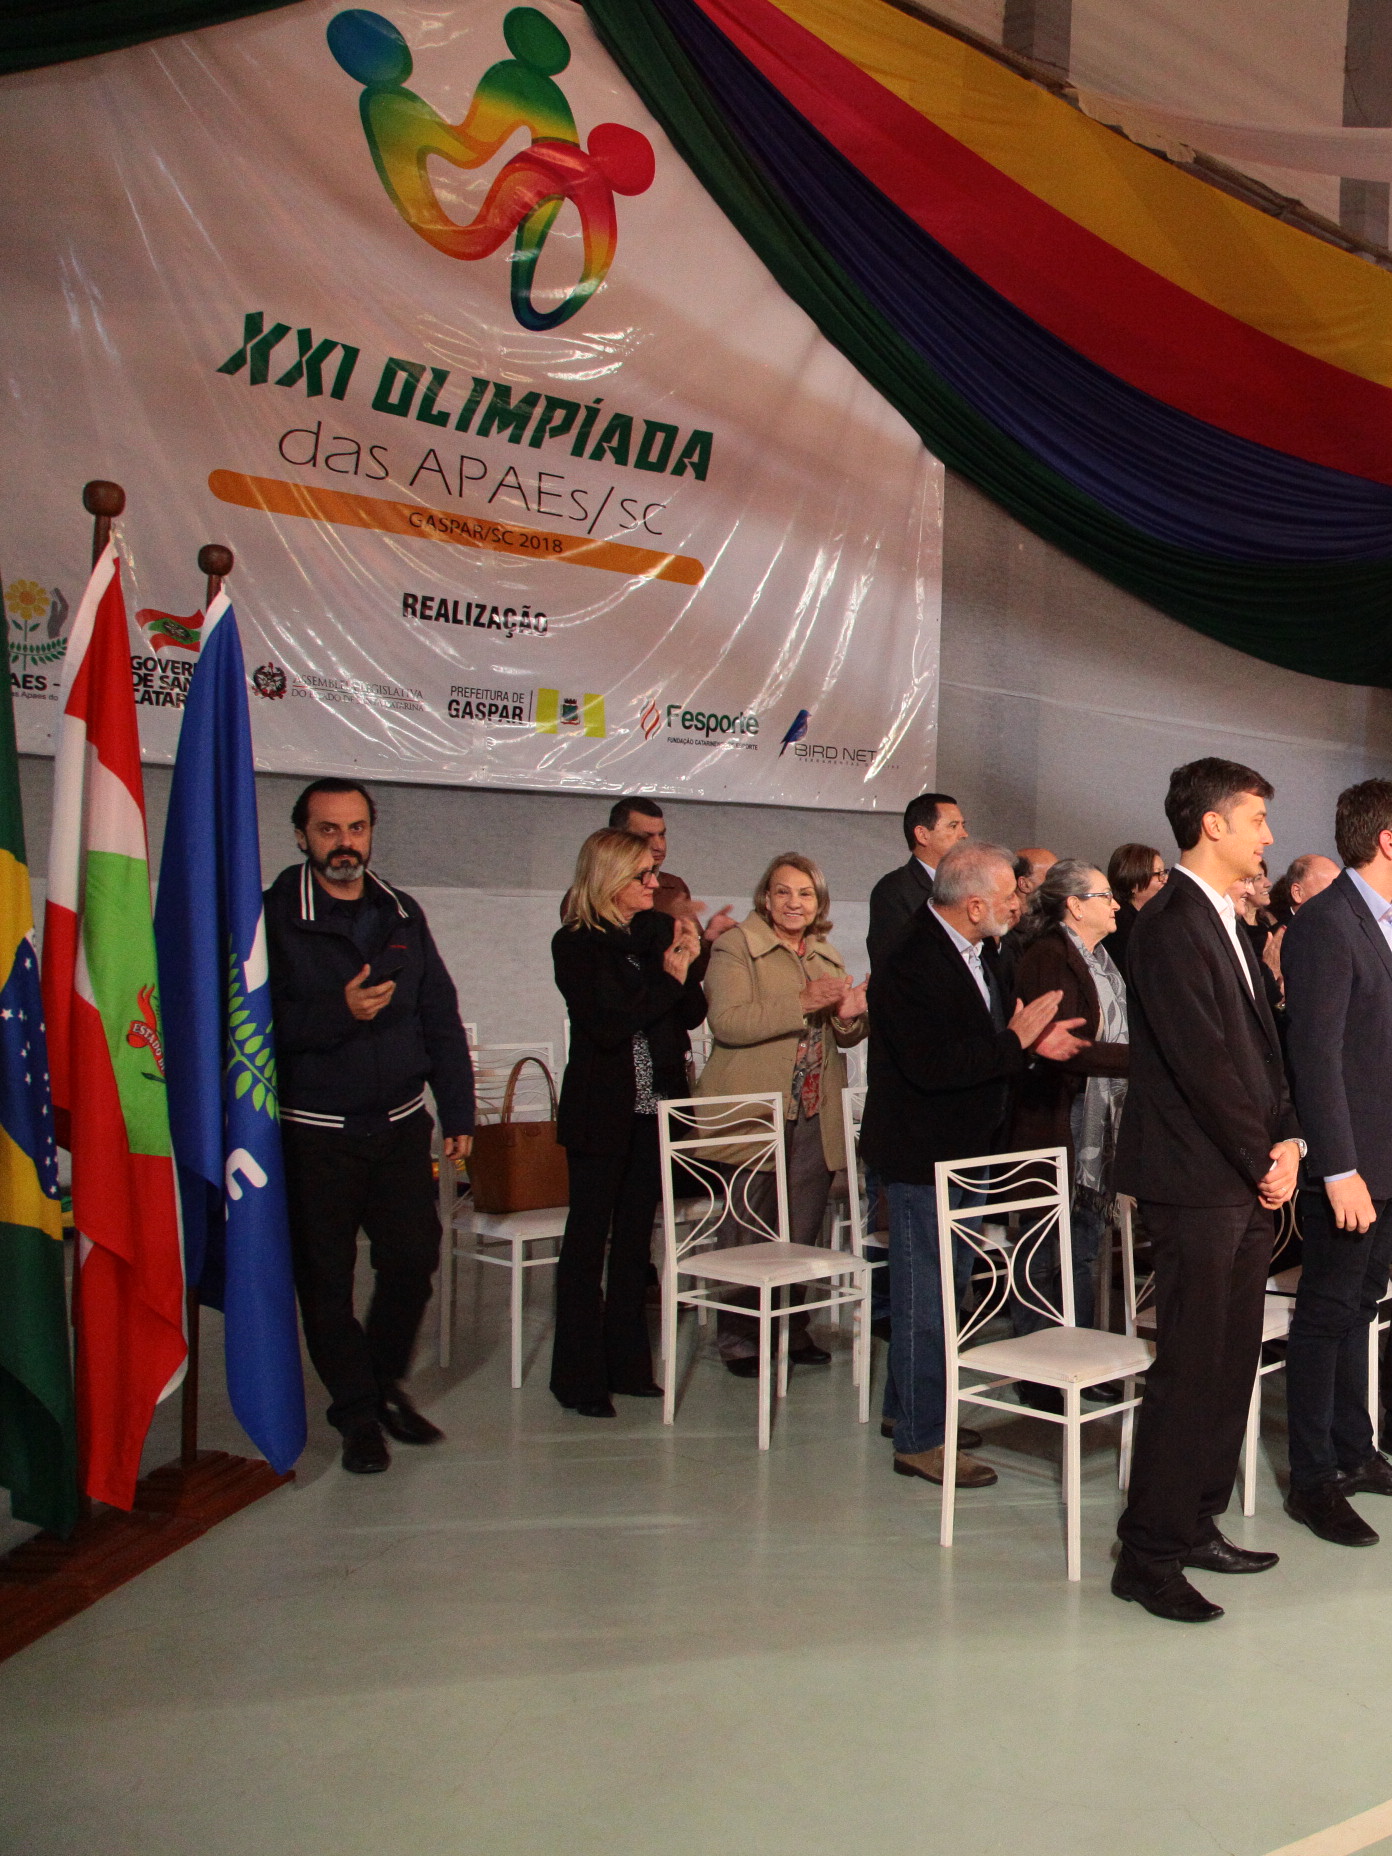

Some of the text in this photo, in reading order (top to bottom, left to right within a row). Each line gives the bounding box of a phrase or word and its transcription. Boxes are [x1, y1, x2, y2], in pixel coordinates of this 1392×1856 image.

[216, 311, 715, 483] XXI OLIMPÍADA
[278, 420, 391, 481] das
[408, 510, 564, 554] GASPAR/SC 2018
[402, 592, 548, 638] REALIZAÇÃO
[130, 655, 195, 677] GOVER
[133, 689, 187, 710] CATAR
[447, 699, 525, 724] GASPAR
[450, 686, 526, 704] PREFEITURA DE
[666, 704, 760, 738] Fesporte
[795, 743, 878, 763] BIRD NET
[132, 1022, 163, 1057] ESTADO
